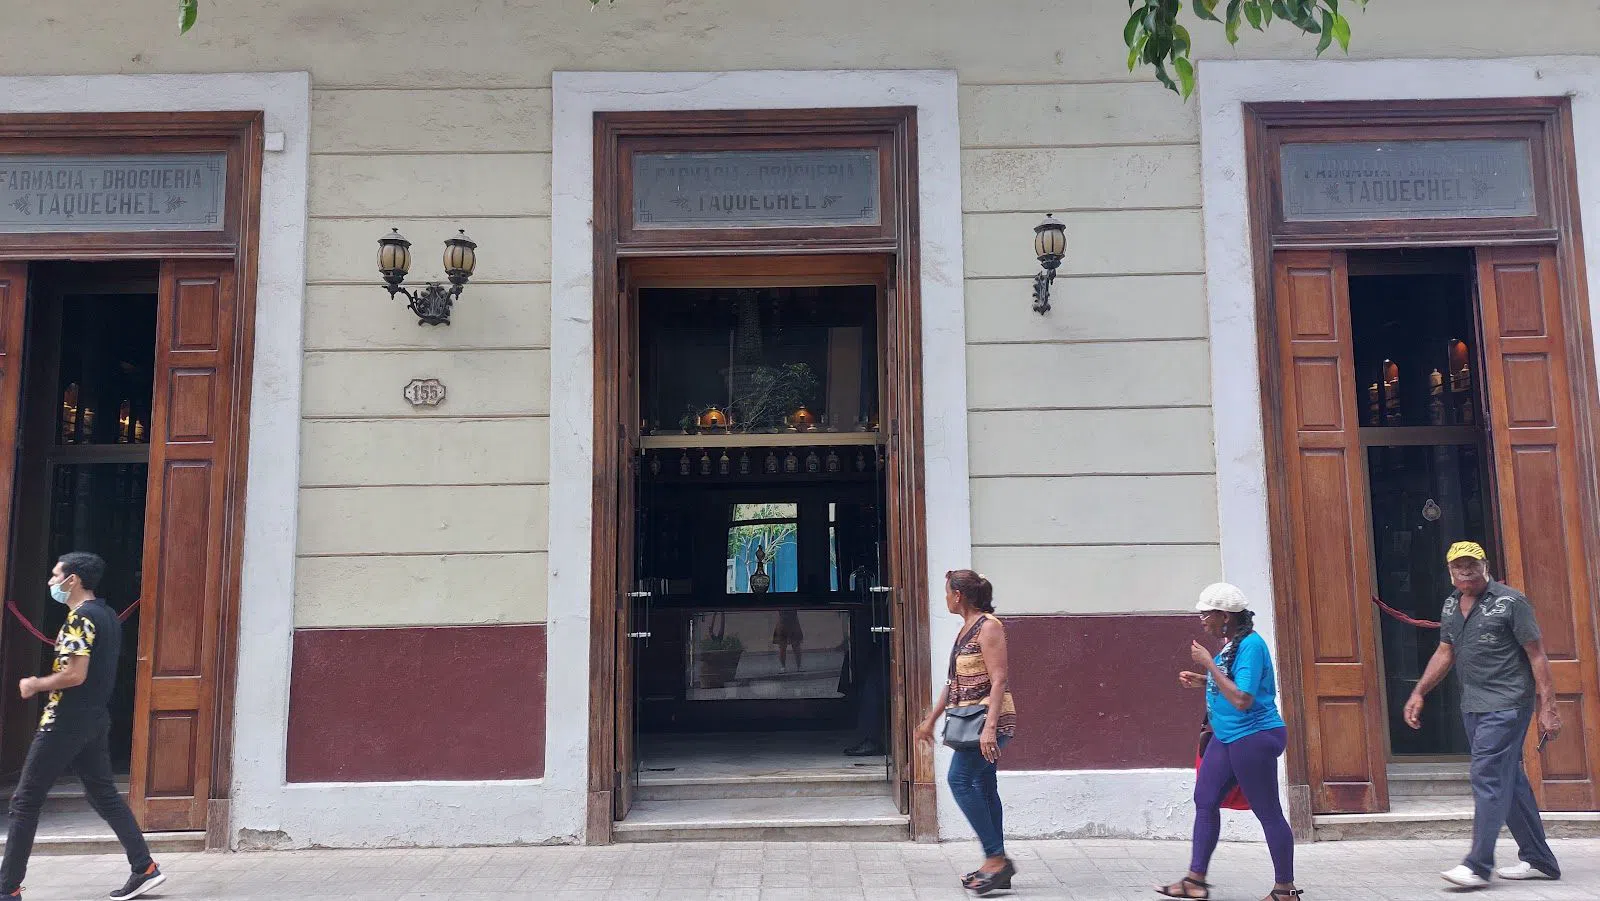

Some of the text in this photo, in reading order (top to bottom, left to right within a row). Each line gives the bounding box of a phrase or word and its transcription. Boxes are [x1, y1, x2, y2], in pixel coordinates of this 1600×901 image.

[102, 168, 202, 189] DROGUERIA
[697, 190, 817, 215] TAQUECHEL
[1345, 179, 1468, 204] TAQUECHEL
[36, 192, 160, 219] TAQUECHEL
[412, 384, 438, 401] 155
